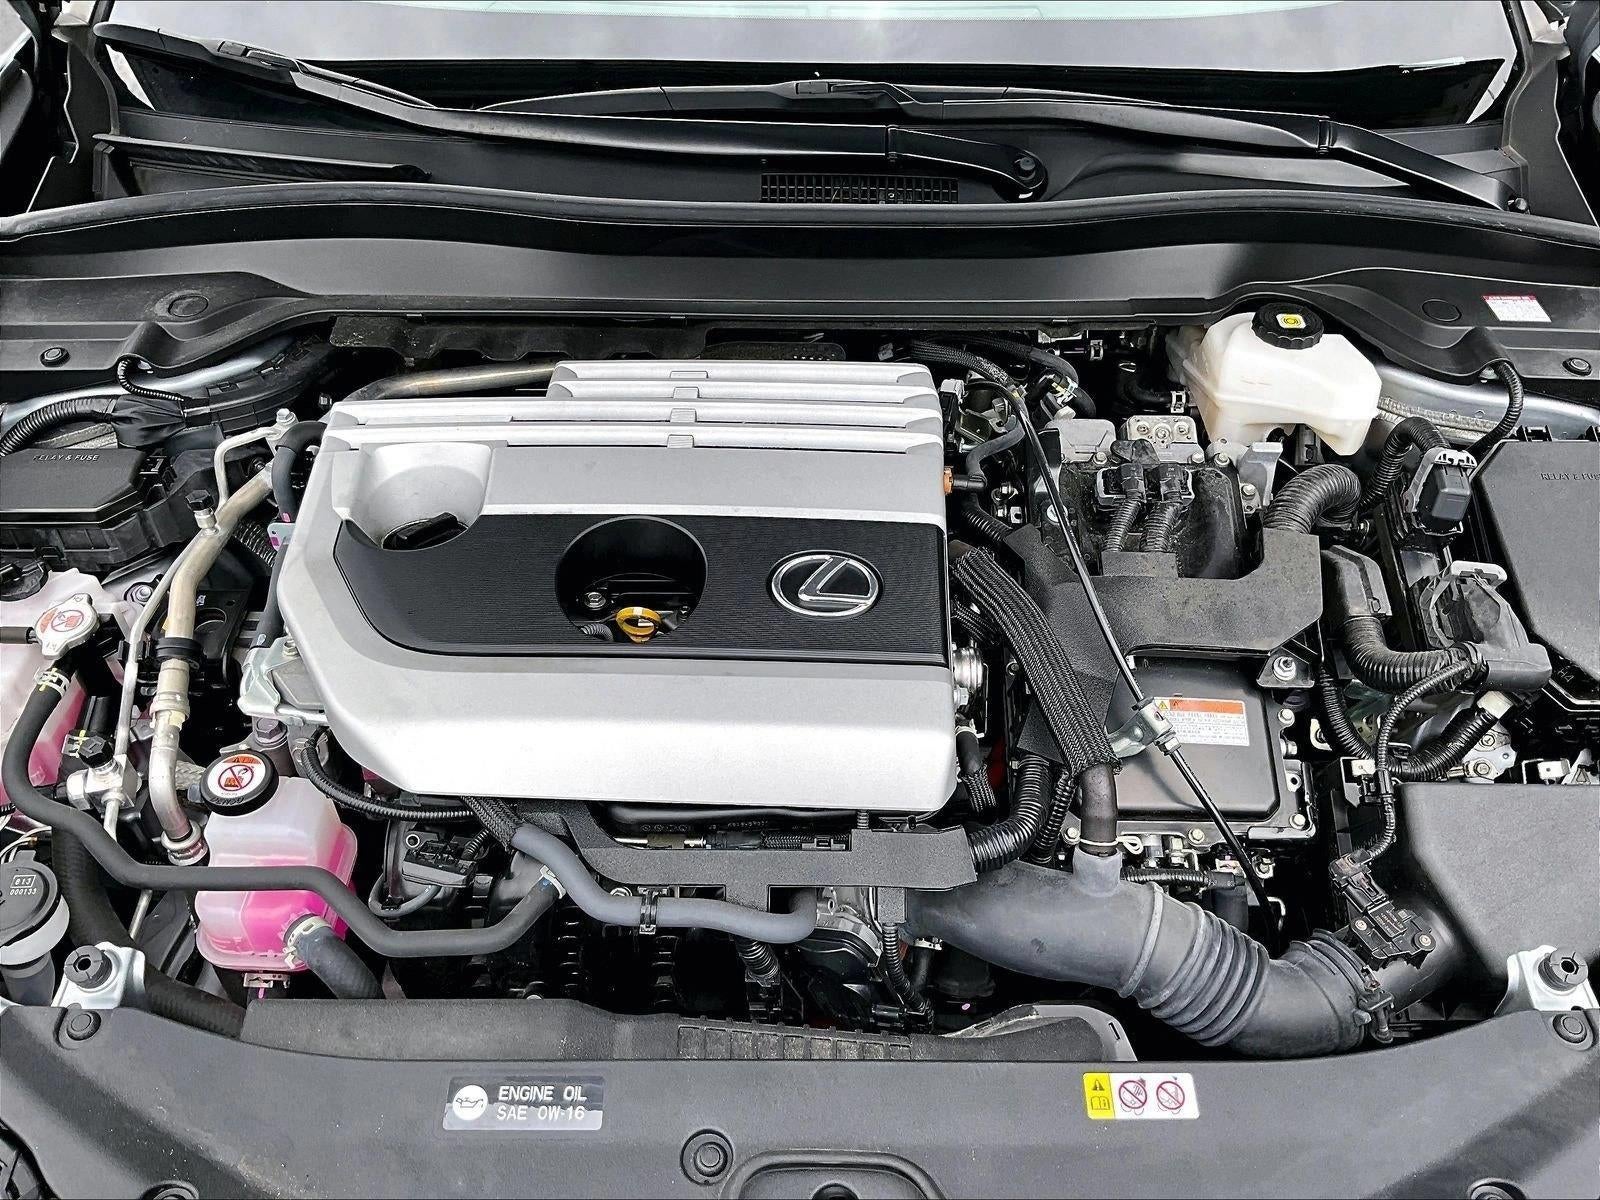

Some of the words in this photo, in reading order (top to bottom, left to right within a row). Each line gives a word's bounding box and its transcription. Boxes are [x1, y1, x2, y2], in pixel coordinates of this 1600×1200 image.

[498, 1085, 555, 1101] ENGINE
[563, 1085, 588, 1101] OIL
[496, 1105, 528, 1121] SAE
